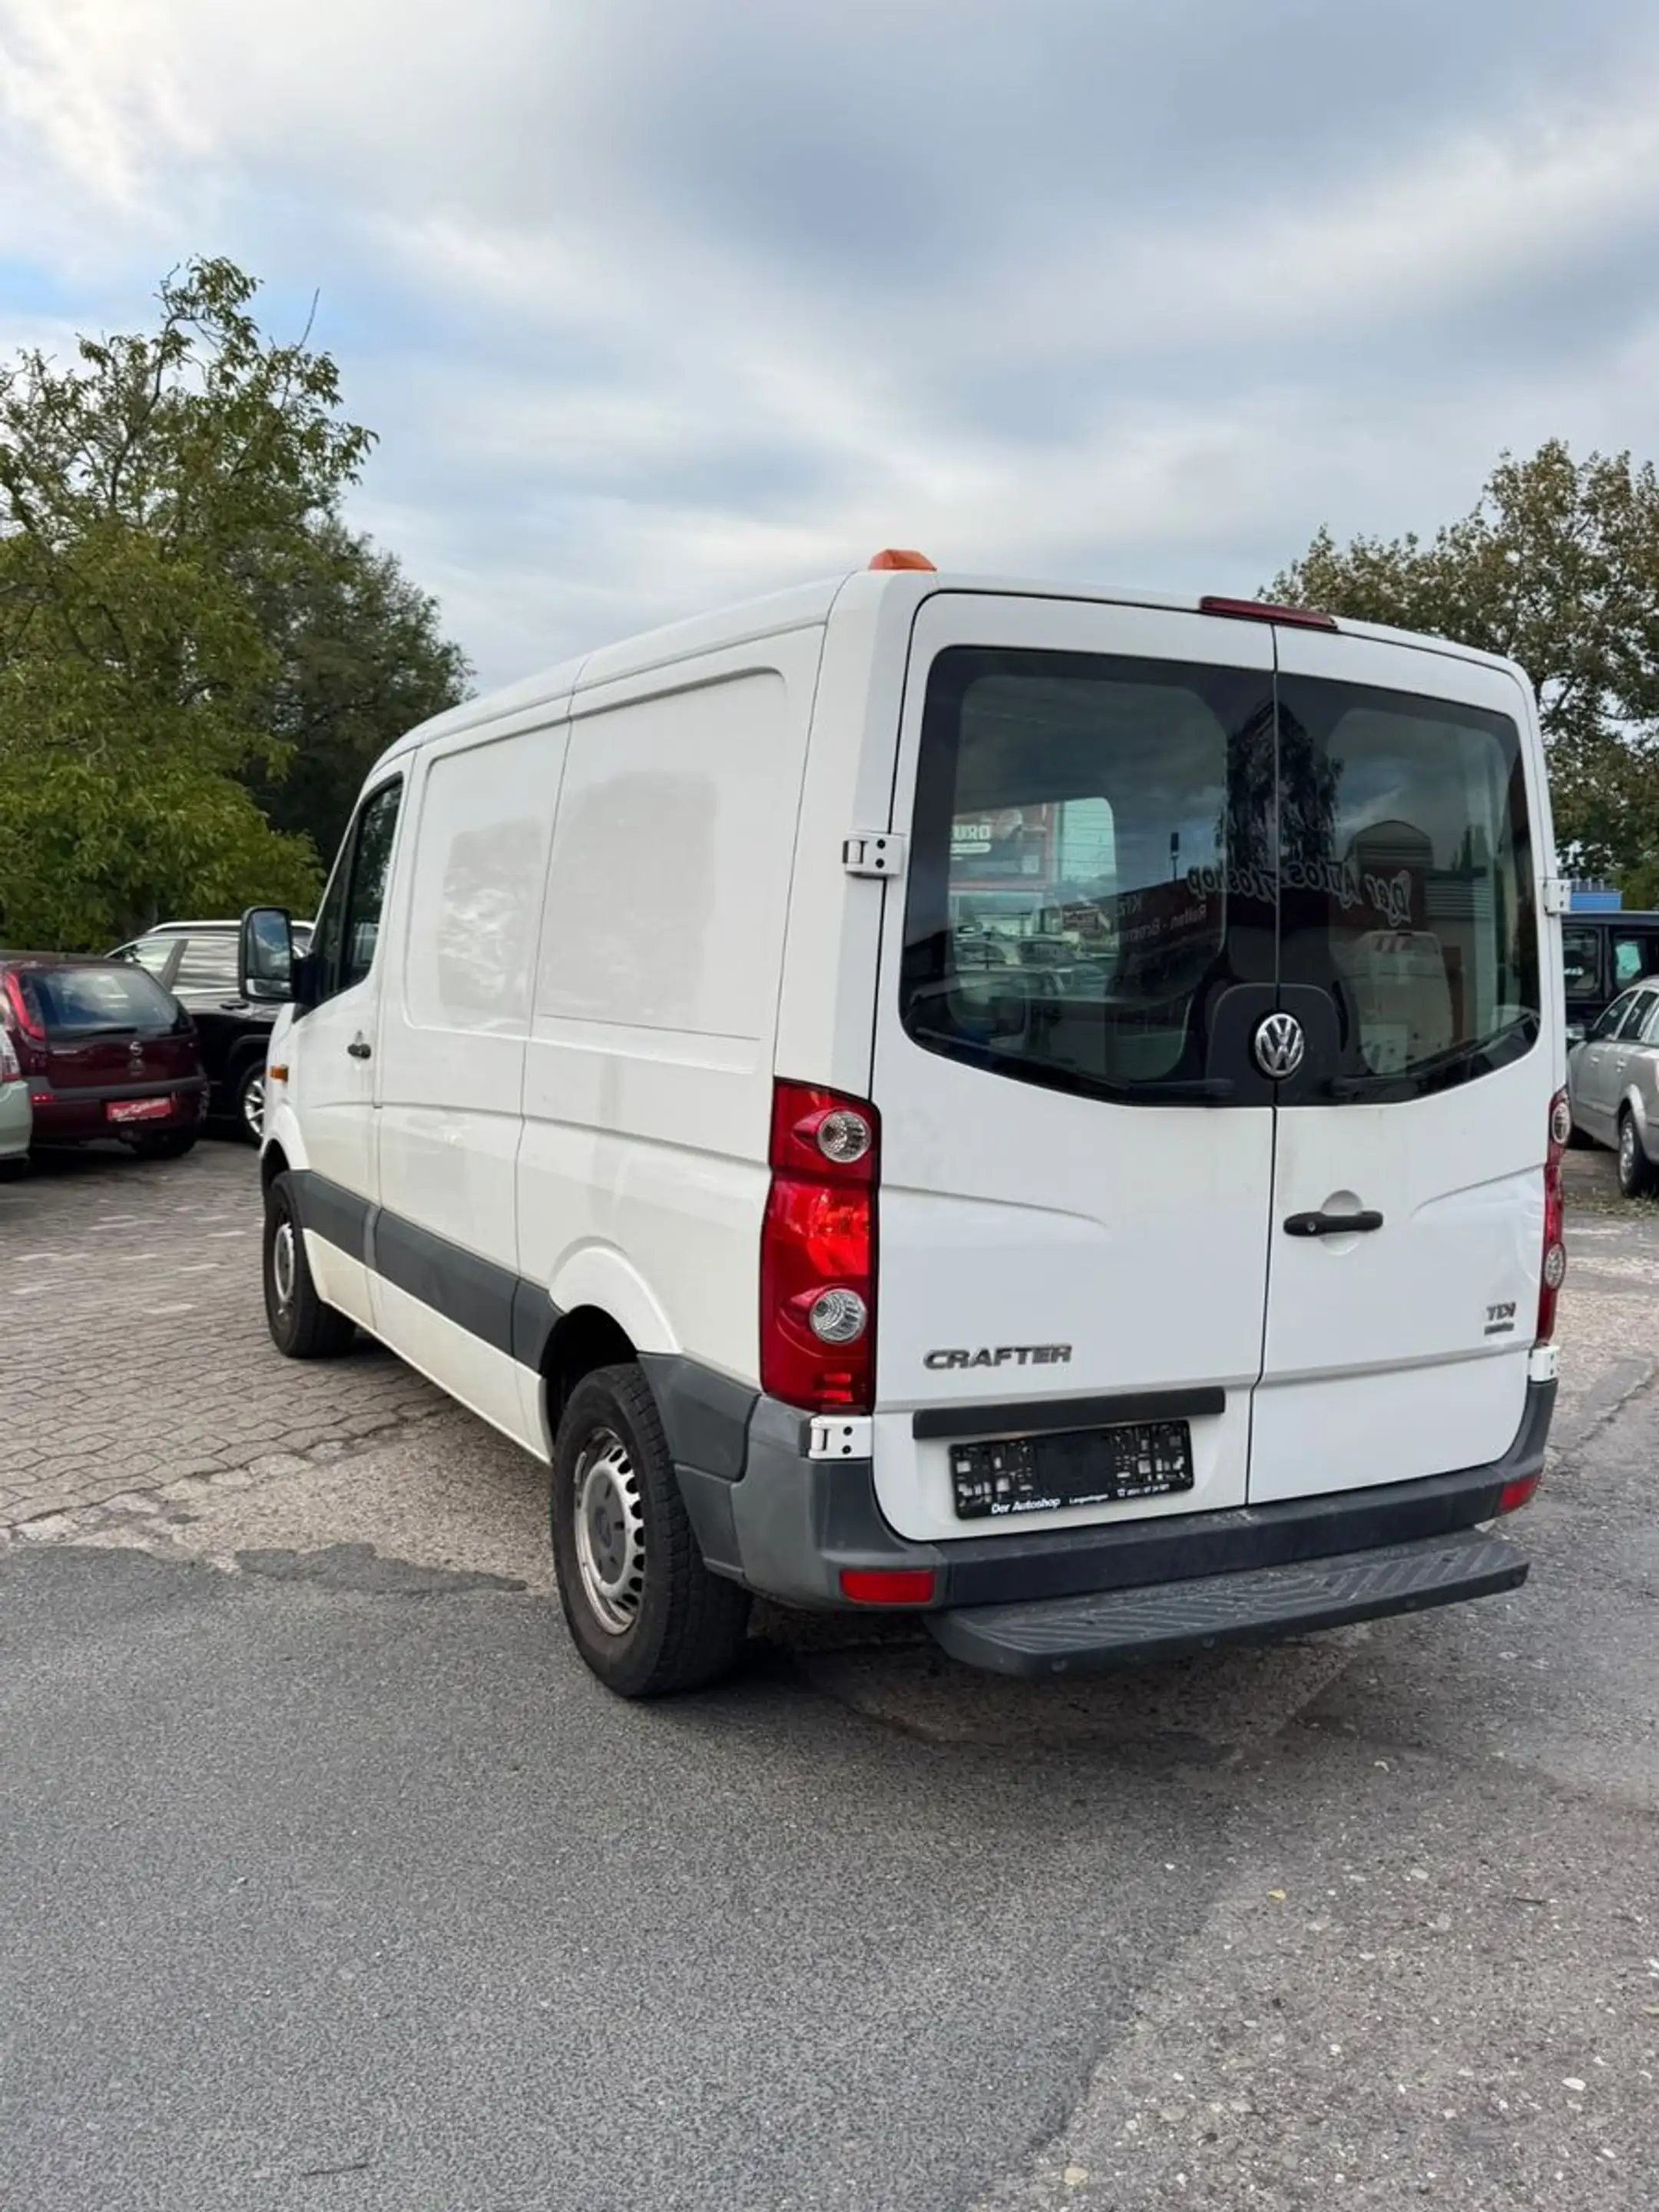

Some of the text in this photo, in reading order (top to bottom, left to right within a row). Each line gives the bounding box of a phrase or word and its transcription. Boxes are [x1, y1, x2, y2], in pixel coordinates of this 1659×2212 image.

[923, 1345, 1072, 1369] CRAFTER
[991, 1502, 1011, 1515] Der
[1012, 1497, 1061, 1512] Autoshop
